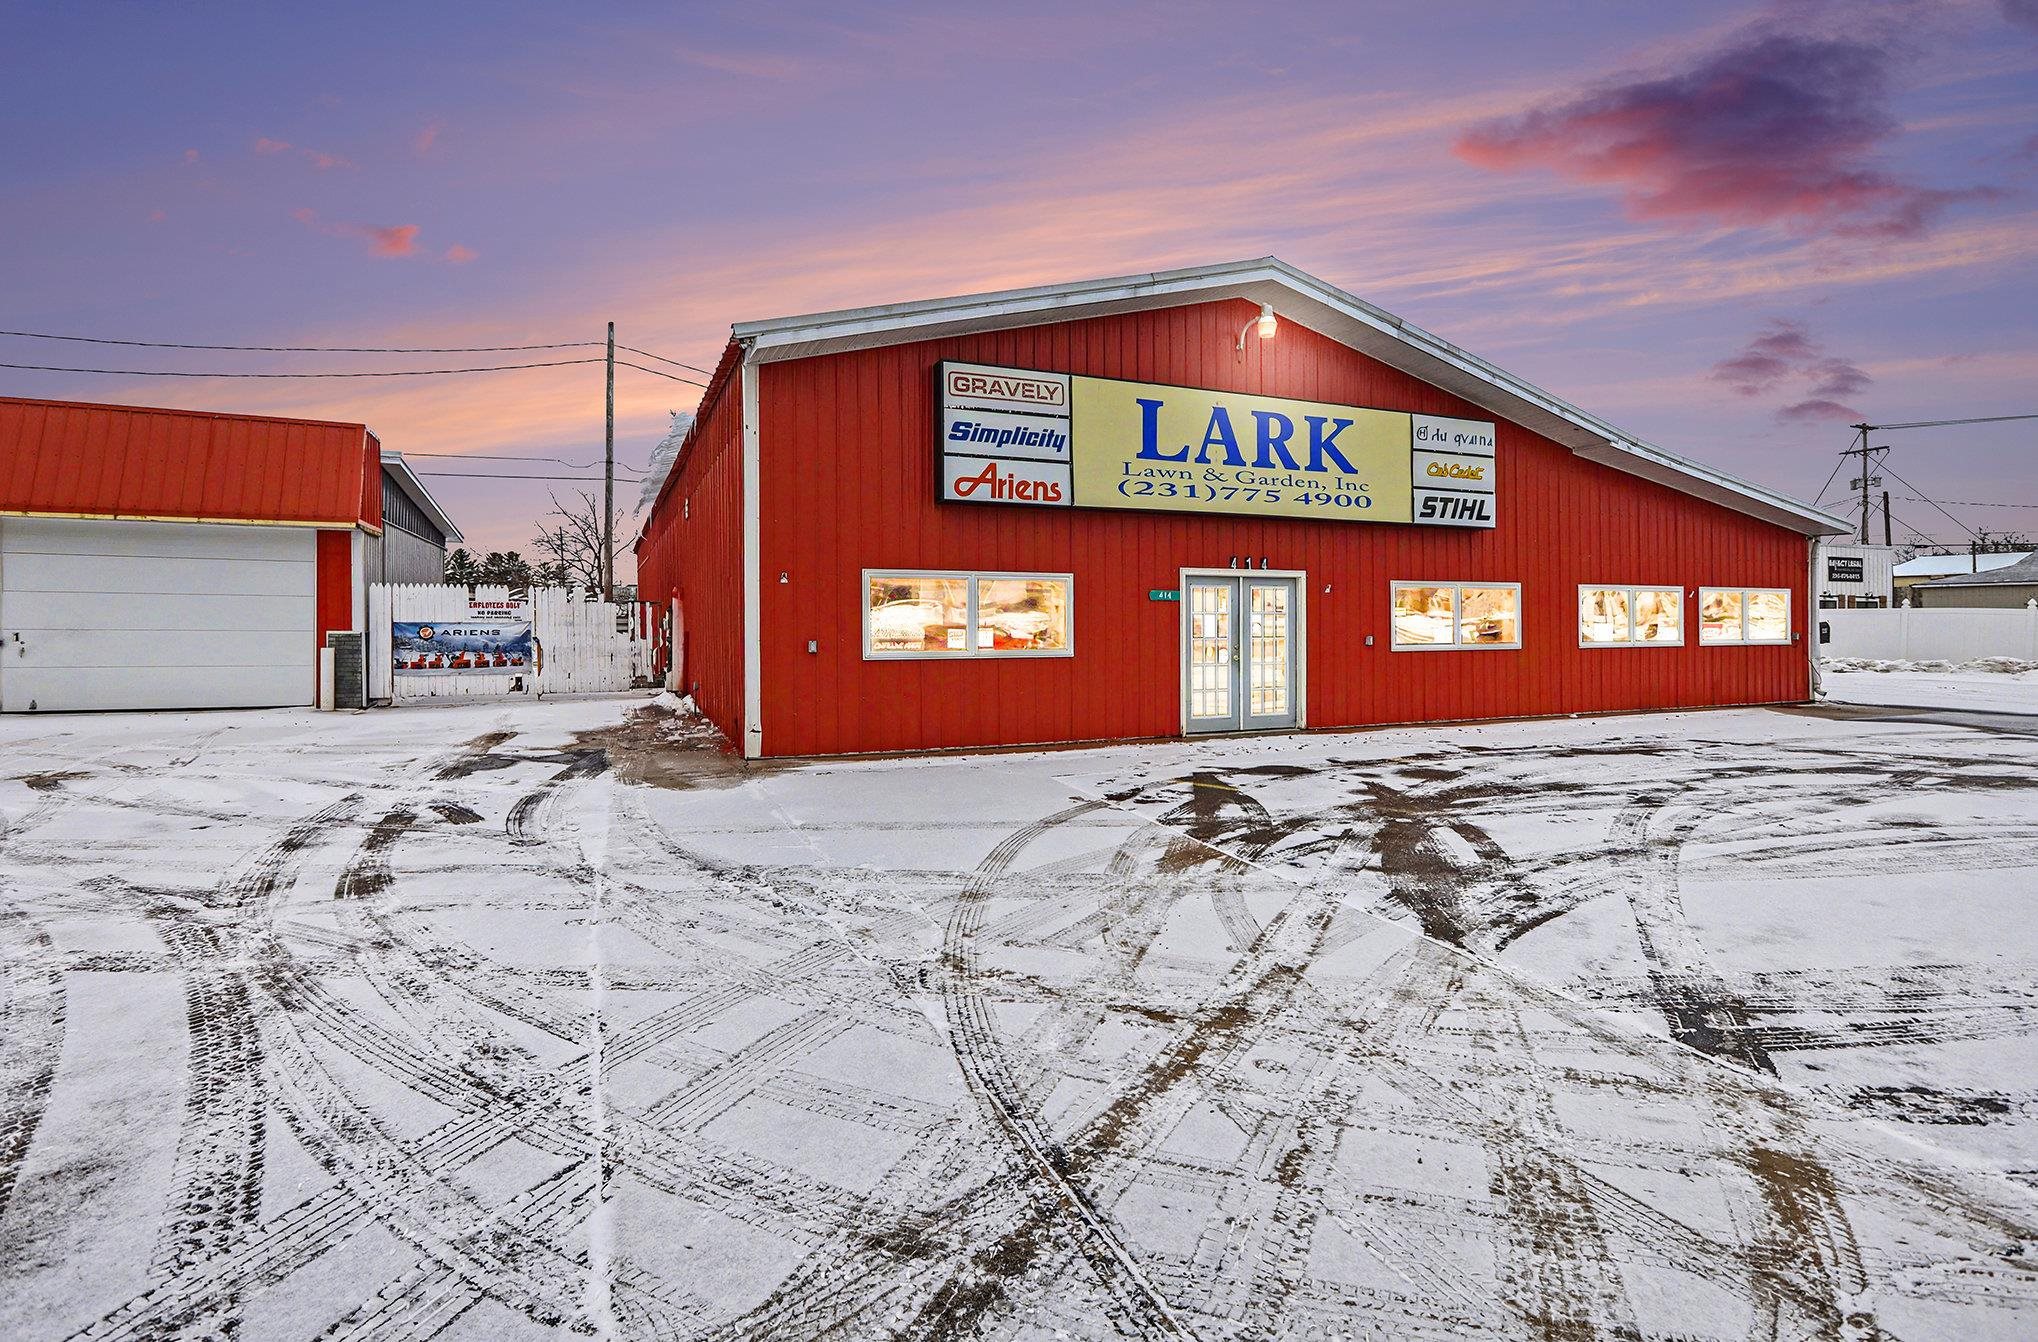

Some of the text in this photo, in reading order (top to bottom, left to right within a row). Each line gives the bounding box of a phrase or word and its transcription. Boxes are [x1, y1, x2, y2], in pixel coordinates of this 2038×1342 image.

[953, 376, 1059, 400] GRAVELY
[948, 421, 1066, 452] Simplicity
[1136, 398, 1358, 474] LARK
[954, 463, 1062, 501] Ariens
[1122, 462, 1369, 491] Lawn & Garden, Inc
[1293, 492, 1372, 509] 4900
[1419, 496, 1491, 521] STIHL
[1159, 590, 1172, 599] 414
